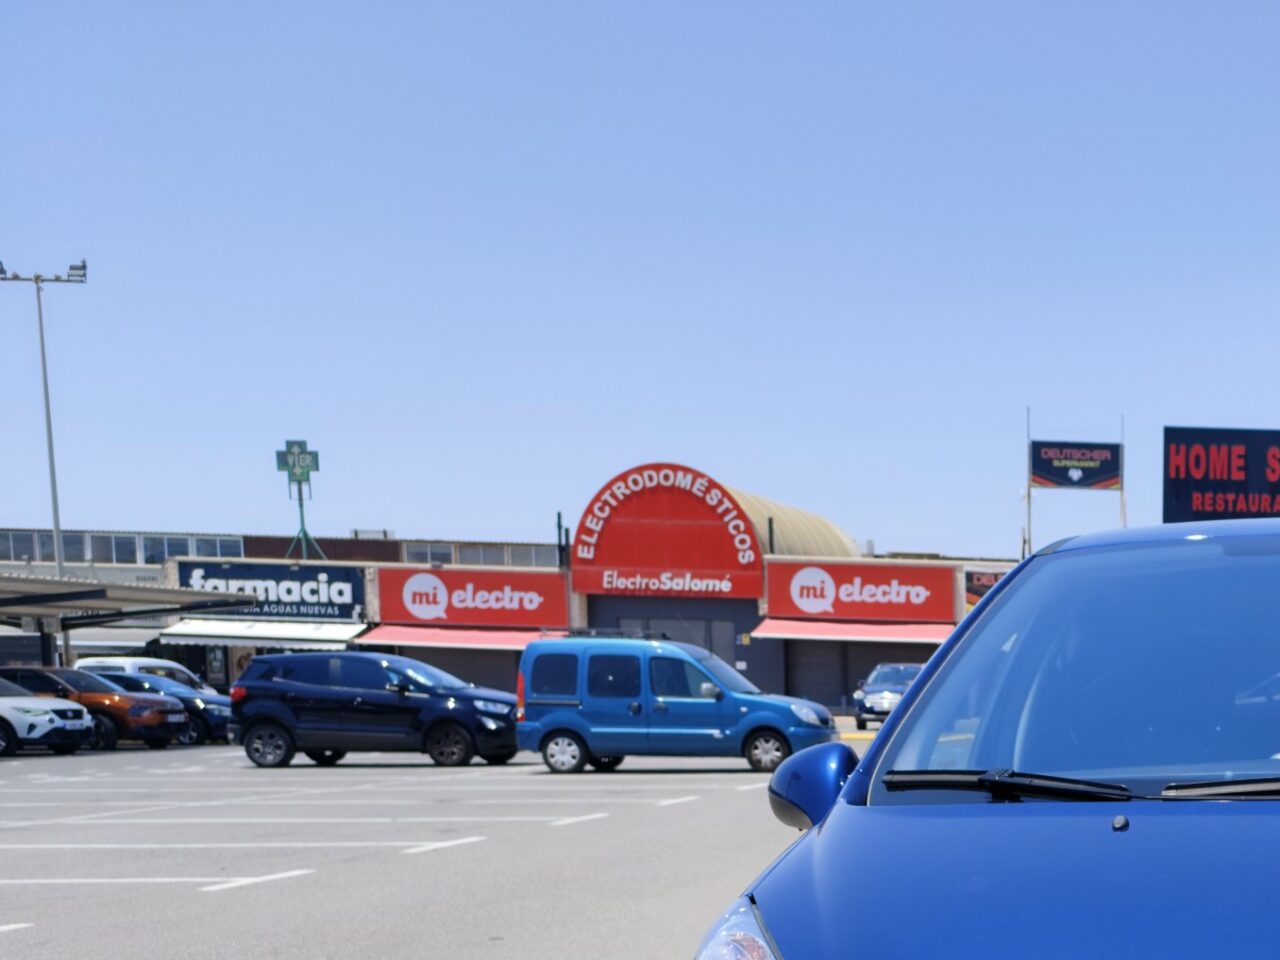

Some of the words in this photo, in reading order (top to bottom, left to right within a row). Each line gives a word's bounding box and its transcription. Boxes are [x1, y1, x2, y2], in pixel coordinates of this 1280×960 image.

[1041, 448, 1111, 460] DEUTSCHER
[1168, 444, 1246, 480] HOME
[577, 469, 755, 565] ELECTRODOMÉSTICOS
[189, 568, 353, 604] farmacia
[603, 570, 732, 592] ElectroSalomé
[800, 580, 827, 599] mi
[838, 576, 931, 605] electro
[263, 604, 297, 614] AGUAS
[300, 605, 339, 616] NUEVAS
[411, 586, 440, 605] mi
[451, 582, 544, 610] electro
